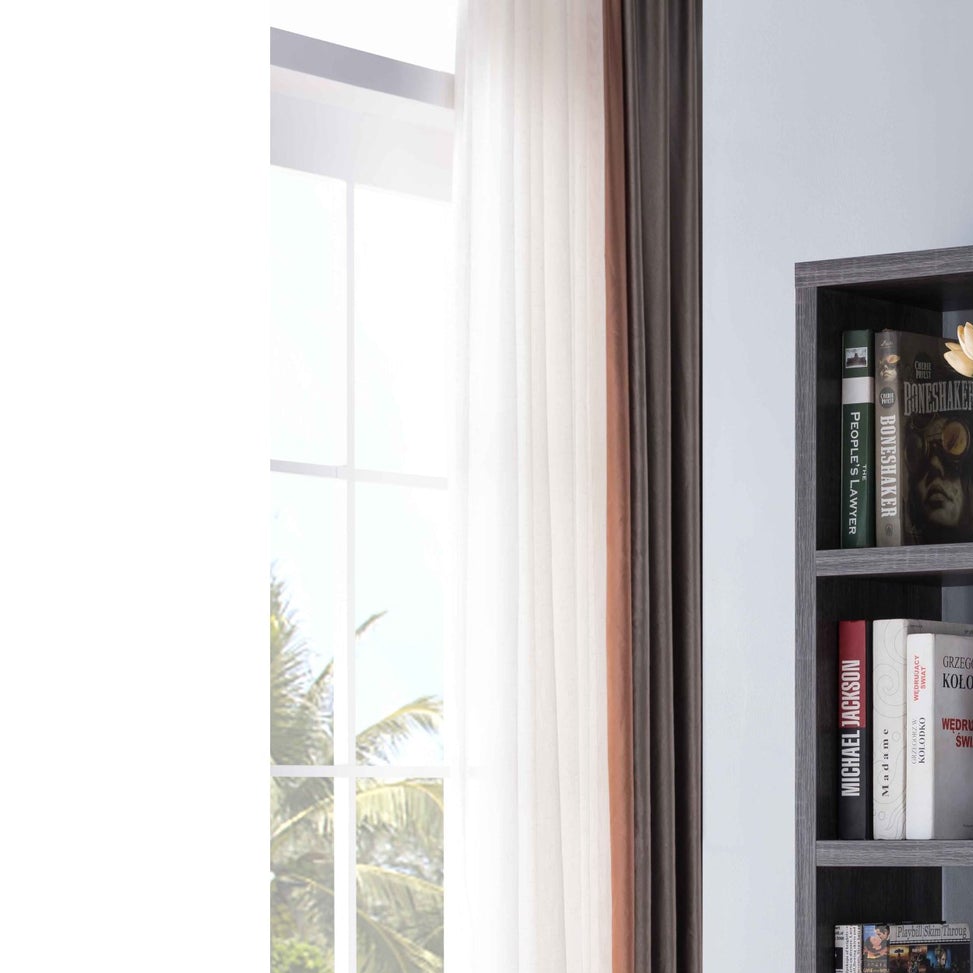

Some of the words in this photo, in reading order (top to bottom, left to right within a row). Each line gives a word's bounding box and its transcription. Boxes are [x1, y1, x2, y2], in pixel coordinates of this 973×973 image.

[850, 411, 860, 475] PEOPLE'S
[880, 415, 897, 518] BONESHAKER
[848, 479, 860, 535] LAWYER
[841, 659, 861, 728] JACKSON
[841, 730, 860, 797] MICHAEL
[881, 729, 890, 797] Madame
[897, 926, 921, 940] Playbill
[923, 926, 940, 938] Skim
